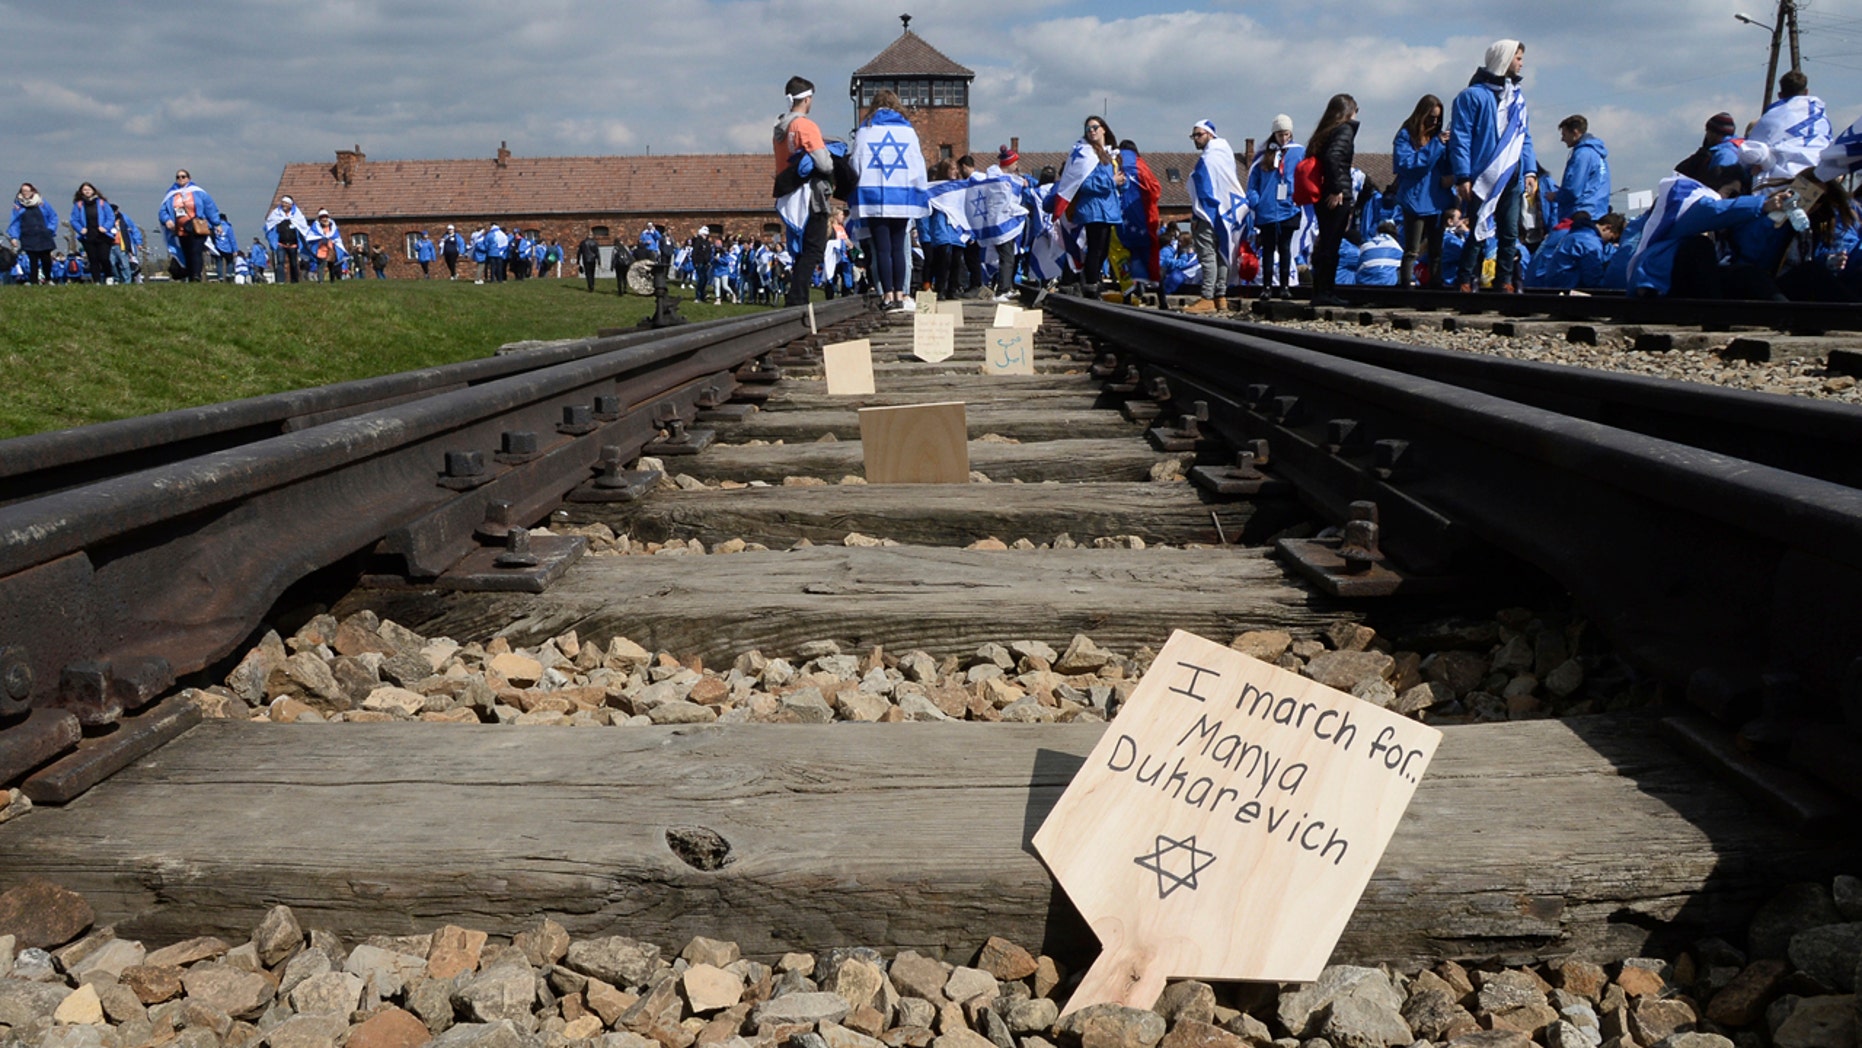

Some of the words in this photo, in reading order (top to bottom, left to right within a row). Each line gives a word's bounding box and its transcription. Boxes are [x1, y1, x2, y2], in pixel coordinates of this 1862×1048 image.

[1168, 661, 1221, 703] I
[1235, 682, 1357, 751] march
[1107, 734, 1348, 865] Dukarevich
[1176, 713, 1308, 799] Manya
